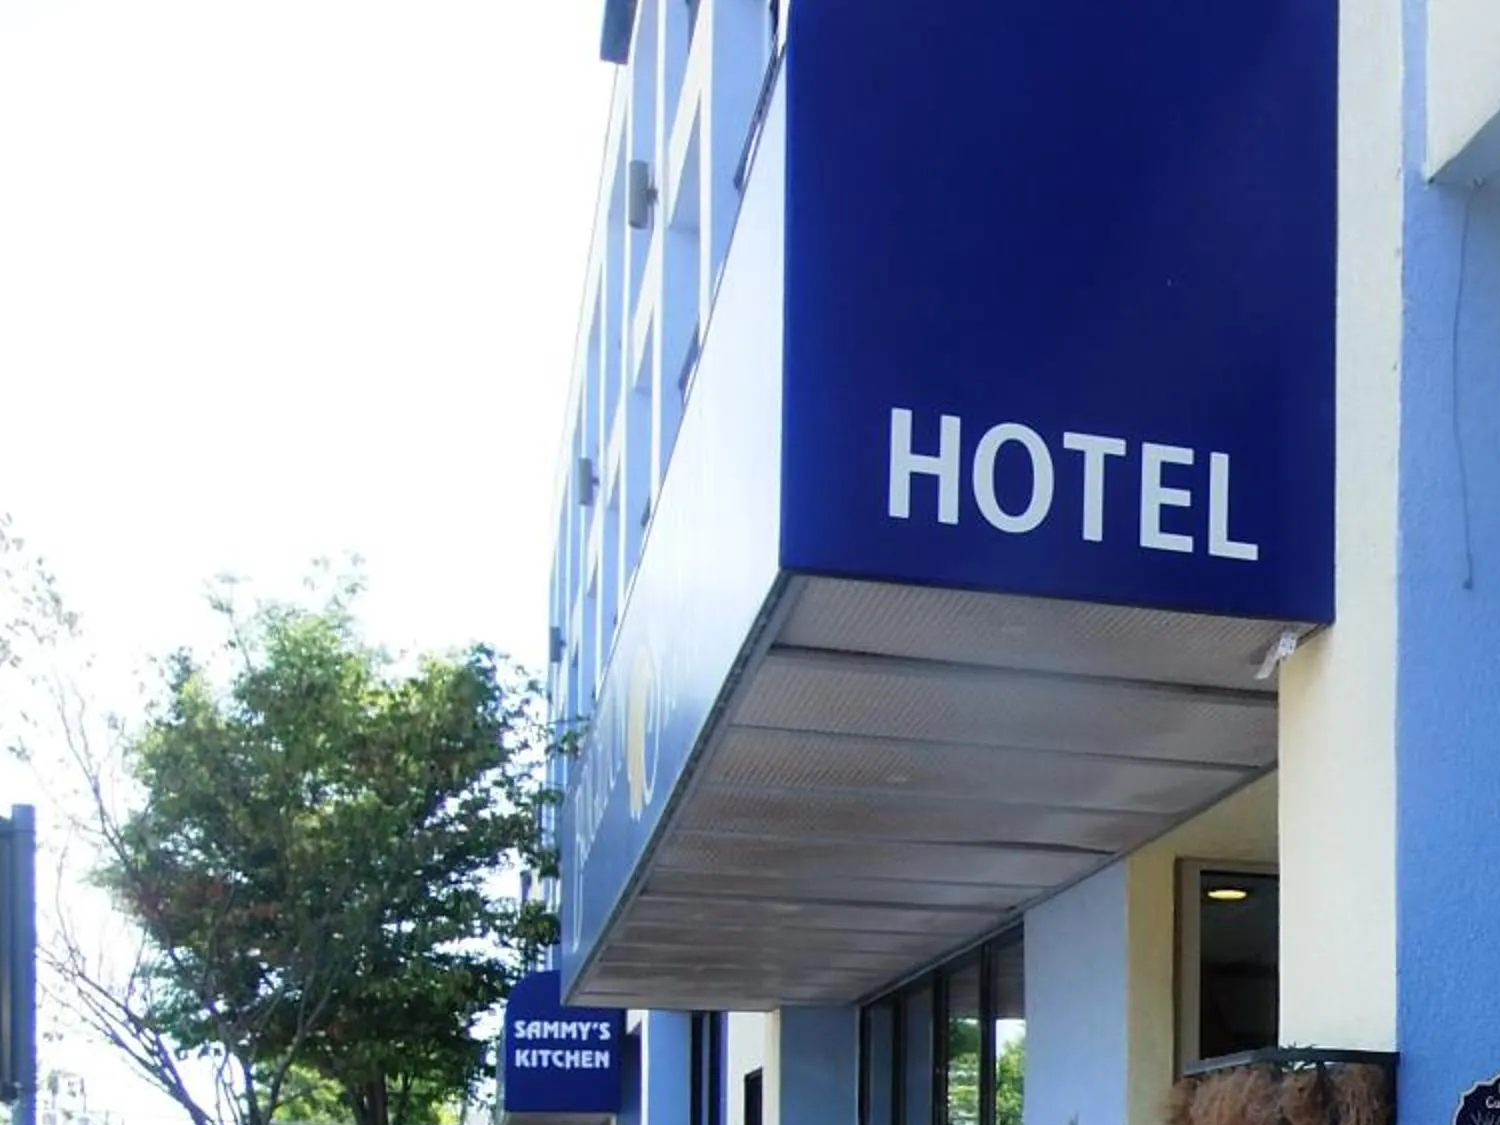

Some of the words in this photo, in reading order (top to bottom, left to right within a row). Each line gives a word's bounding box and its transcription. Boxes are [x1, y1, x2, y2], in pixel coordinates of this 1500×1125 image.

[888, 407, 1258, 560] HOTEL
[514, 1020, 611, 1041] SAMMY'S
[515, 1049, 610, 1069] KITCHEN
